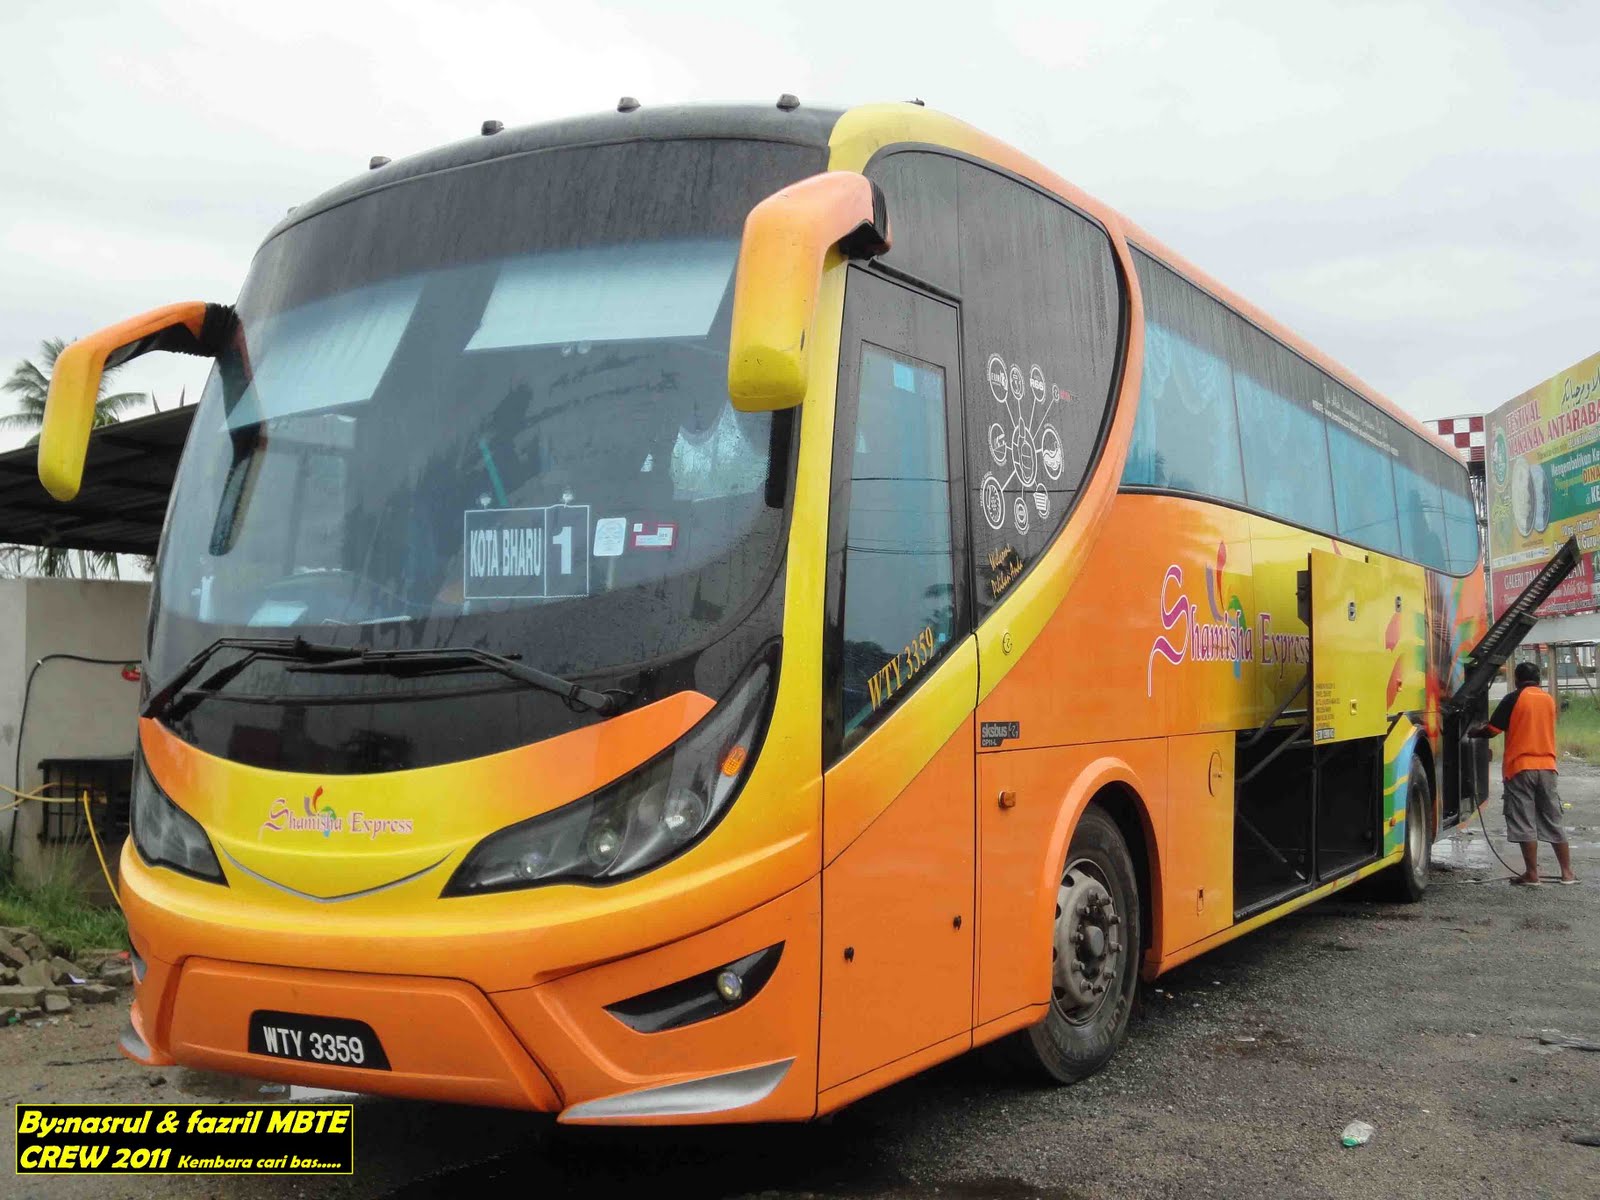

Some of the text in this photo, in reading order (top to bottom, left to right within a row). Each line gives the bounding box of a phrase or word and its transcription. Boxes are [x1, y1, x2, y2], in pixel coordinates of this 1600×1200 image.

[1506, 400, 1541, 436] FESTIVAL
[470, 529, 499, 577] KOTA
[502, 527, 542, 577] BHARU
[552, 526, 573, 575] 1
[1148, 564, 1310, 698] Shamisha Express
[867, 626, 935, 712] WTY 3359
[982, 723, 1008, 738] sksbus
[258, 797, 414, 841] Shamisha Express
[263, 1025, 366, 1065] WTY 3359
